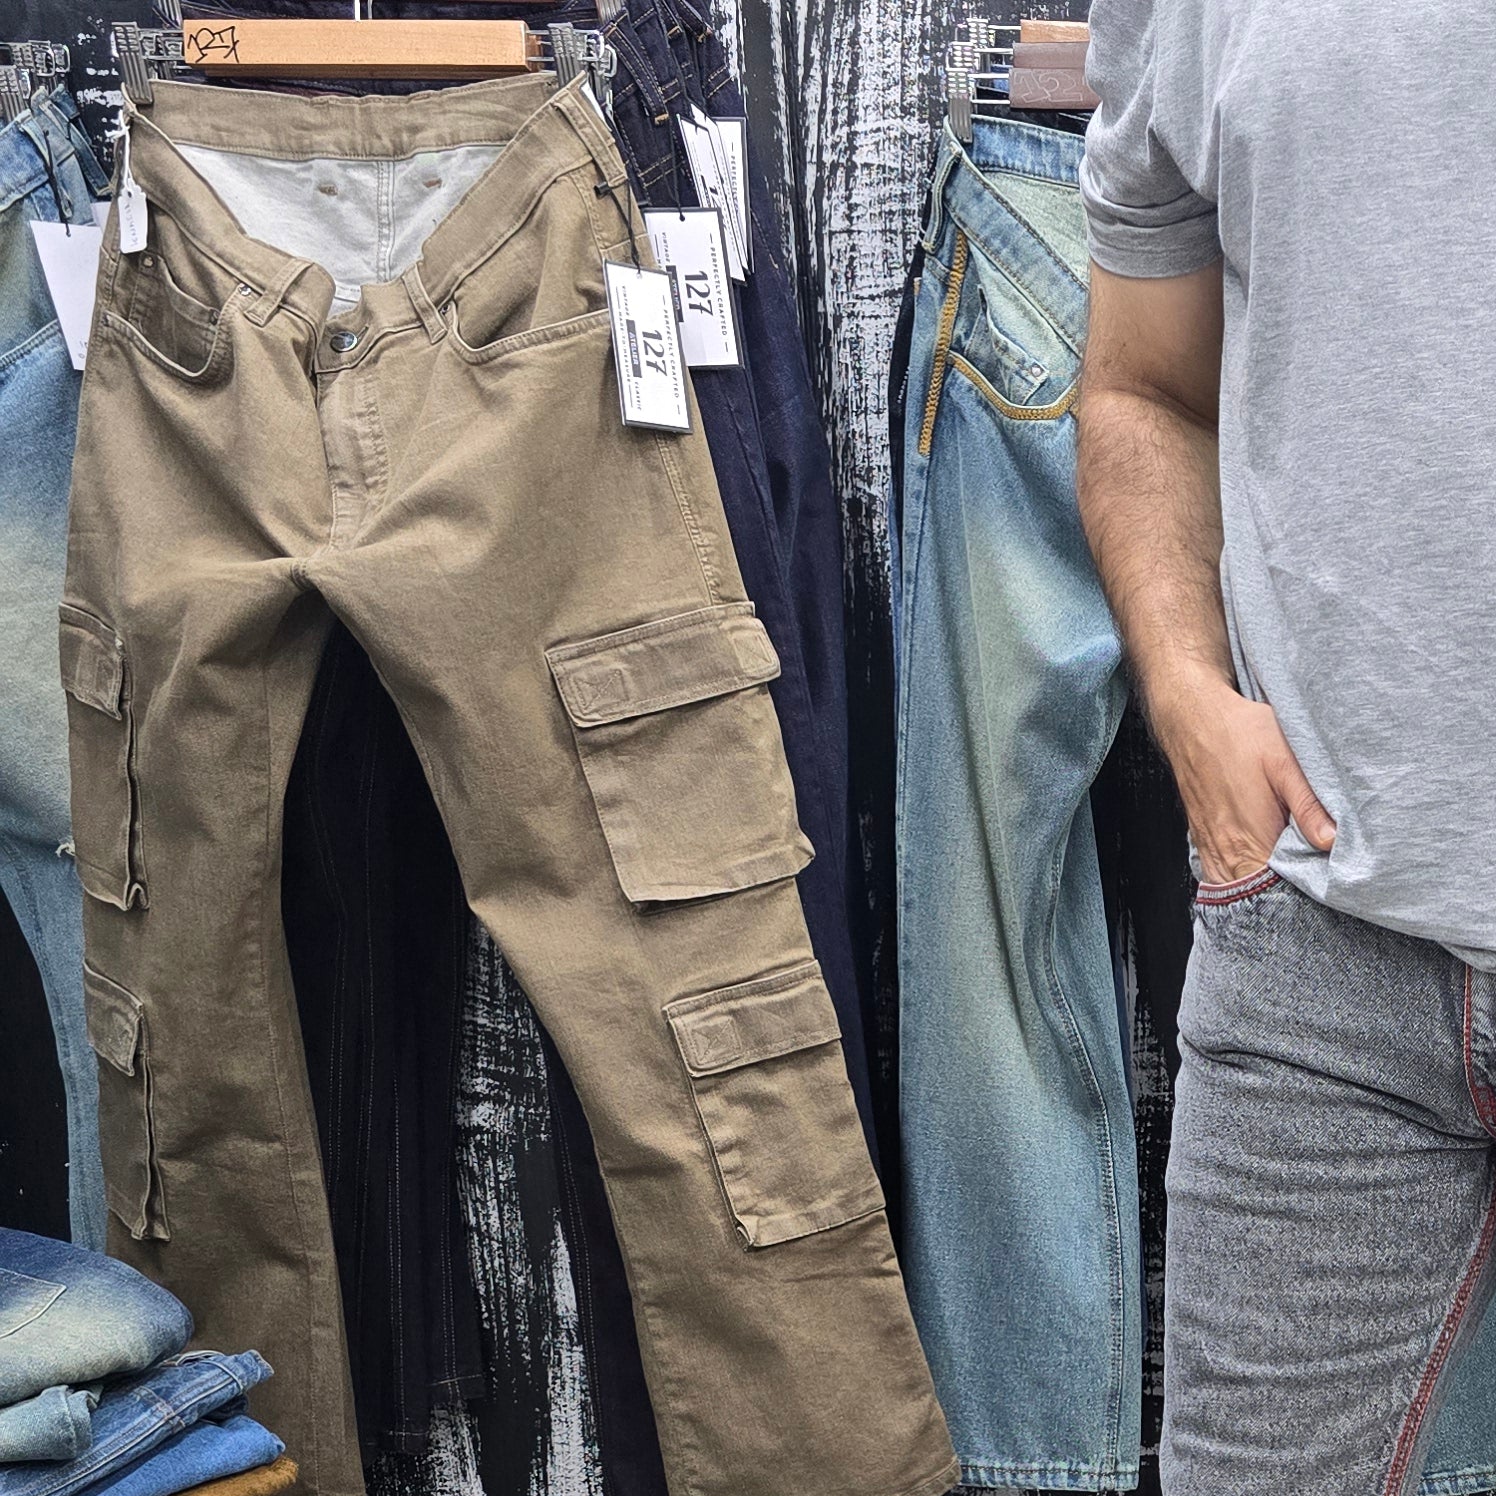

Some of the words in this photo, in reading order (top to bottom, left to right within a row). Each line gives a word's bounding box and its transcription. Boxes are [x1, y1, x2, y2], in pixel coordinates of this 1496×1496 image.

[1013, 71, 1085, 103] 12
[662, 232, 671, 263] VINTAGE
[684, 270, 714, 316] 127
[710, 247, 722, 295] PERFECTLY
[717, 297, 728, 336] CRAFTED
[622, 285, 630, 316] VINTAGE
[628, 331, 639, 365] ATELIER
[634, 381, 642, 411] CLASSIC
[641, 329, 668, 377] 127
[663, 309, 675, 358] PERFECTLY
[670, 359, 680, 399] CRAFTED
